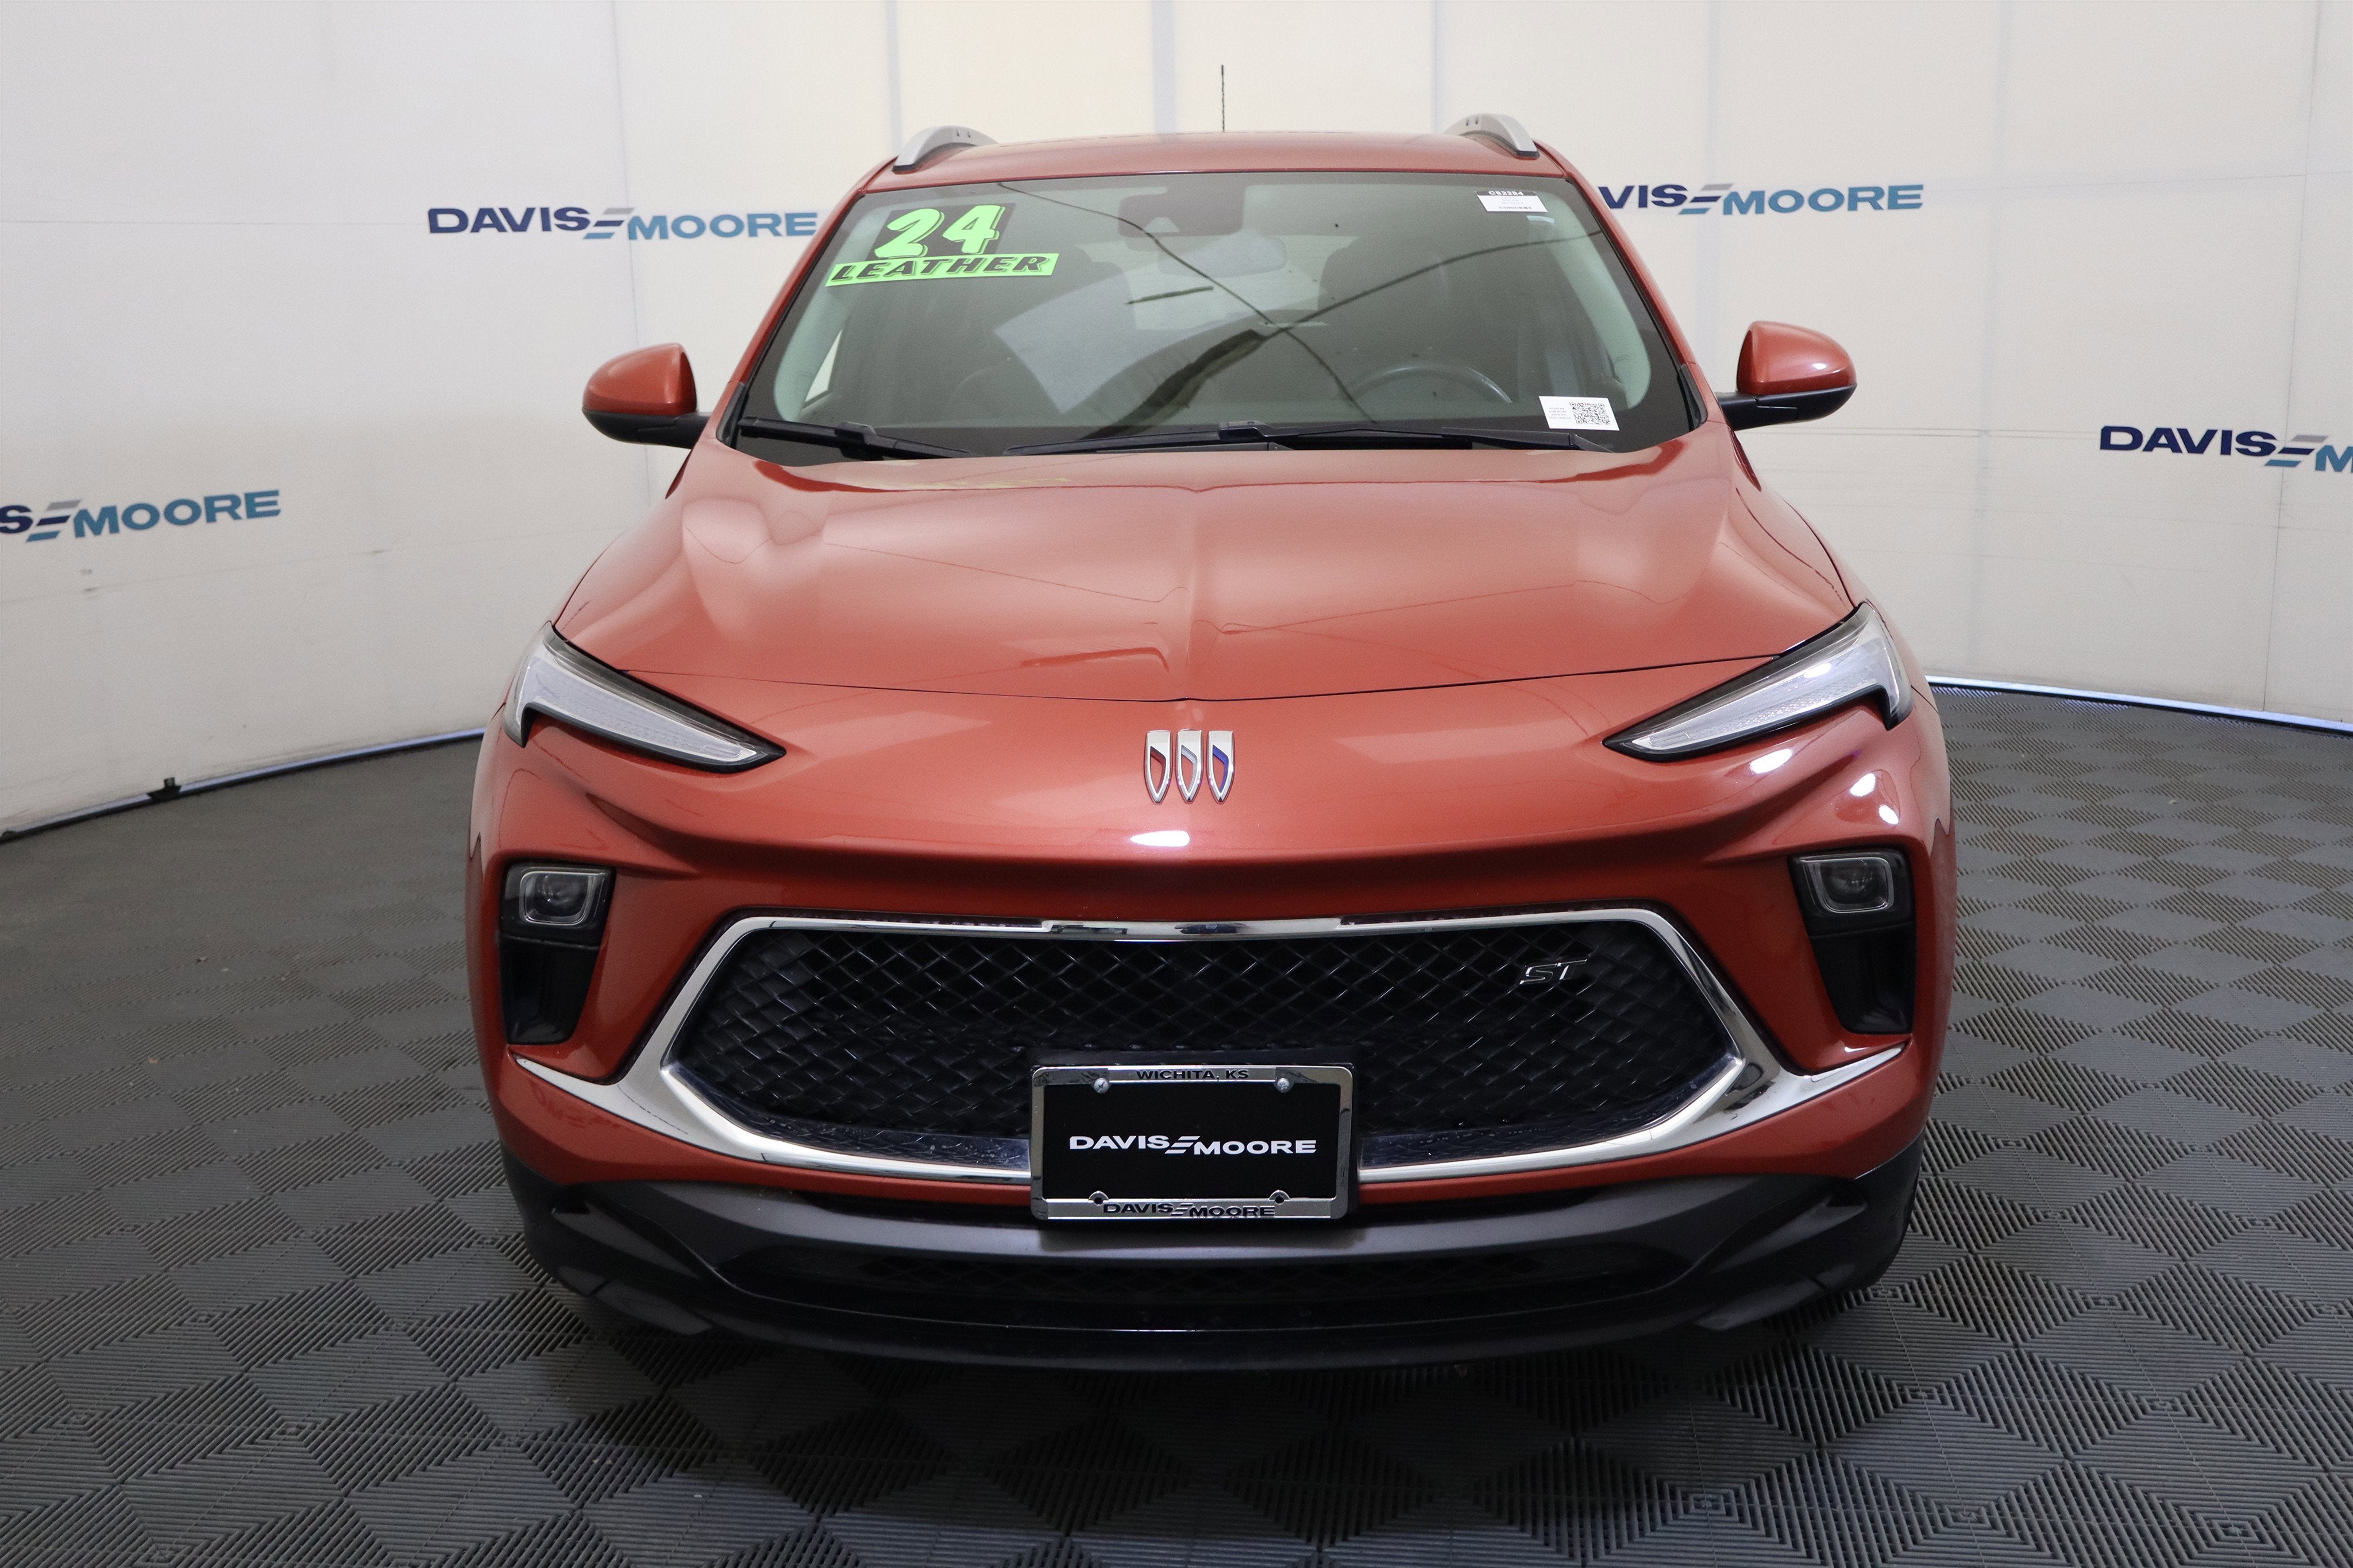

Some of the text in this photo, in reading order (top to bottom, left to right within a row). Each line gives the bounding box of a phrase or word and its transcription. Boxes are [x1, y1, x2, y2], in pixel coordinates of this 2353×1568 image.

[1723, 184, 1924, 215] MOORE
[427, 206, 818, 241] DAVIS MOORE
[874, 204, 1006, 258] 24
[831, 256, 1050, 281] LEATHER
[2100, 426, 2278, 457] DAVIS
[73, 490, 281, 539] MOORE
[1519, 959, 1587, 985] ST
[1225, 1070, 1249, 1079] KS
[1069, 1135, 1317, 1155] DAVIS MOORE
[1102, 1203, 1275, 1217] DAVIS MOORE
